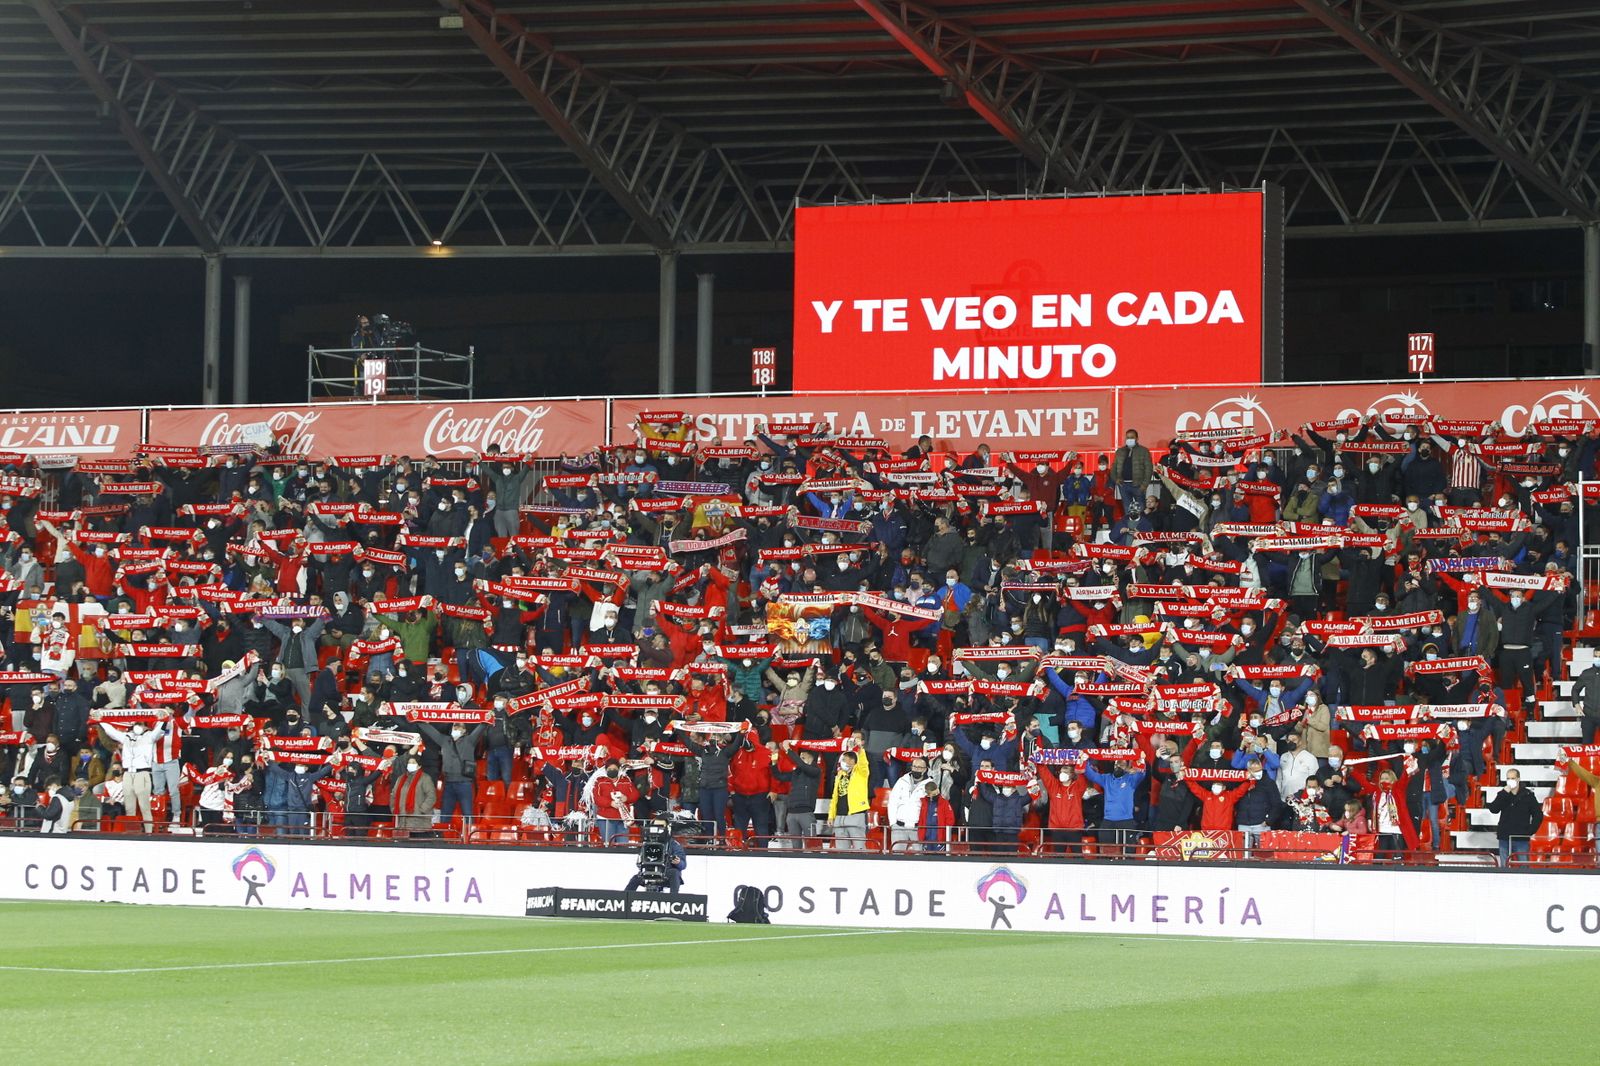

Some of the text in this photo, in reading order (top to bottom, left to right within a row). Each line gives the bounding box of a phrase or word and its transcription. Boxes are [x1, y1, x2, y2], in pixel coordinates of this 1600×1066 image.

[812, 290, 1245, 333] Y TE VEO EN CADA
[1409, 336, 1429, 351] 117
[753, 350, 771, 365] 118
[933, 343, 1117, 381] MINUTO
[1409, 354, 1428, 372] 17
[367, 361, 384, 376] 119
[753, 368, 771, 385] 18
[366, 378, 382, 395] 19
[881, 418, 905, 431] DE
[911, 407, 1099, 438] LEVANTE
[664, 604, 674, 612] UD
[1339, 636, 1350, 645] UD
[1185, 770, 1198, 779] UD
[292, 866, 482, 903] ALMERÍA
[560, 898, 625, 912] #FANCAM
[631, 900, 705, 916] #FANCAM
[1045, 886, 1262, 926] ALMERÍA
